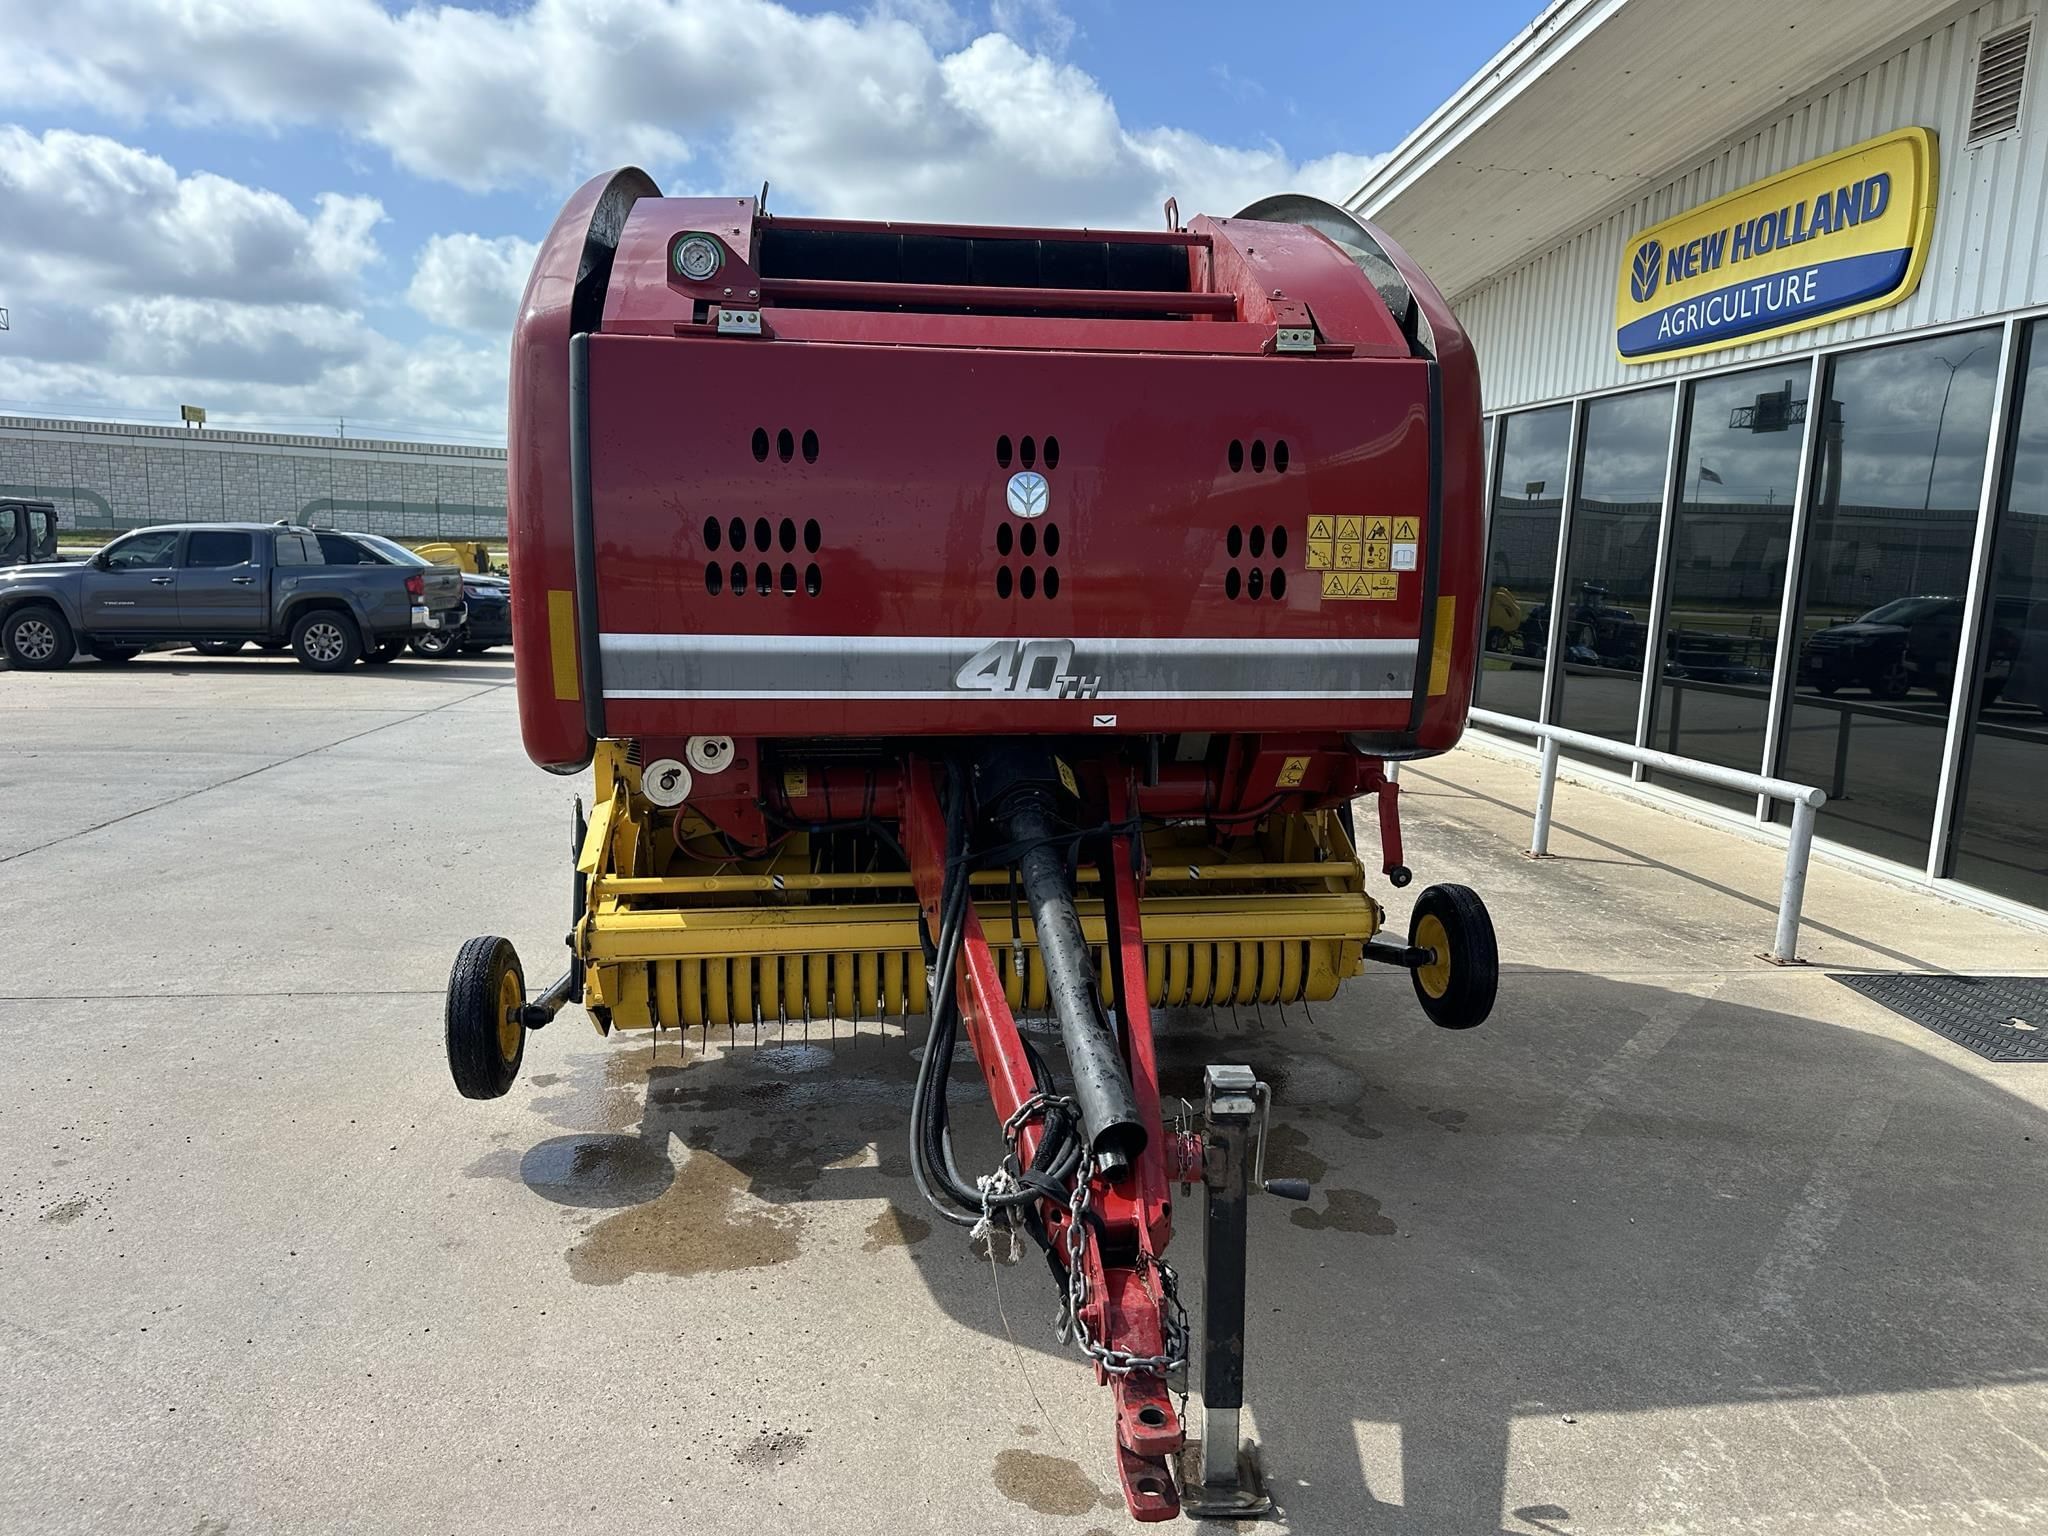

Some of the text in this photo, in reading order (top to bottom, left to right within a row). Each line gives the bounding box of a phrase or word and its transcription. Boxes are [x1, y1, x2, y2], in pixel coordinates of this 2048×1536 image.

[1665, 172, 1890, 285] NEW HOLLAND
[1657, 269, 1818, 340] AGRICULTURE
